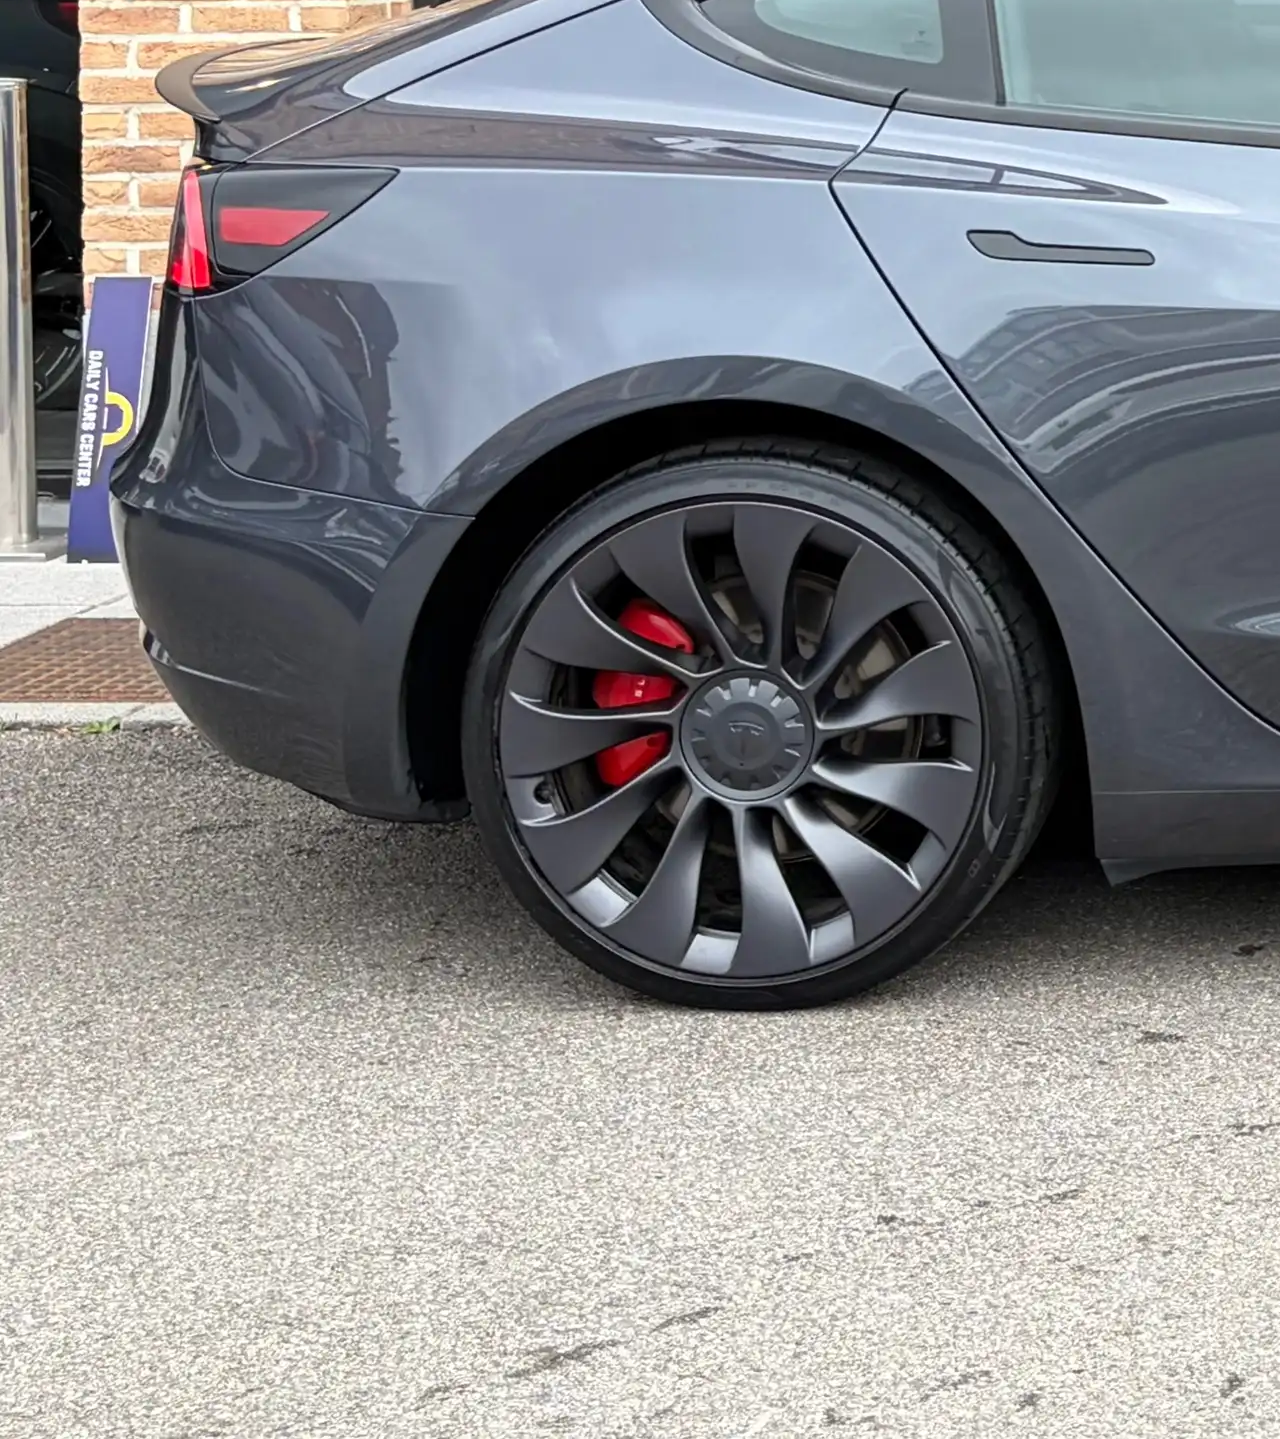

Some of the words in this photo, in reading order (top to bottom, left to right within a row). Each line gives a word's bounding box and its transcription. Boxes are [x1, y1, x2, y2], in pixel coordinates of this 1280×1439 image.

[85, 350, 103, 390] DAILY
[81, 393, 98, 431] CARS
[76, 434, 94, 487] CENTER
